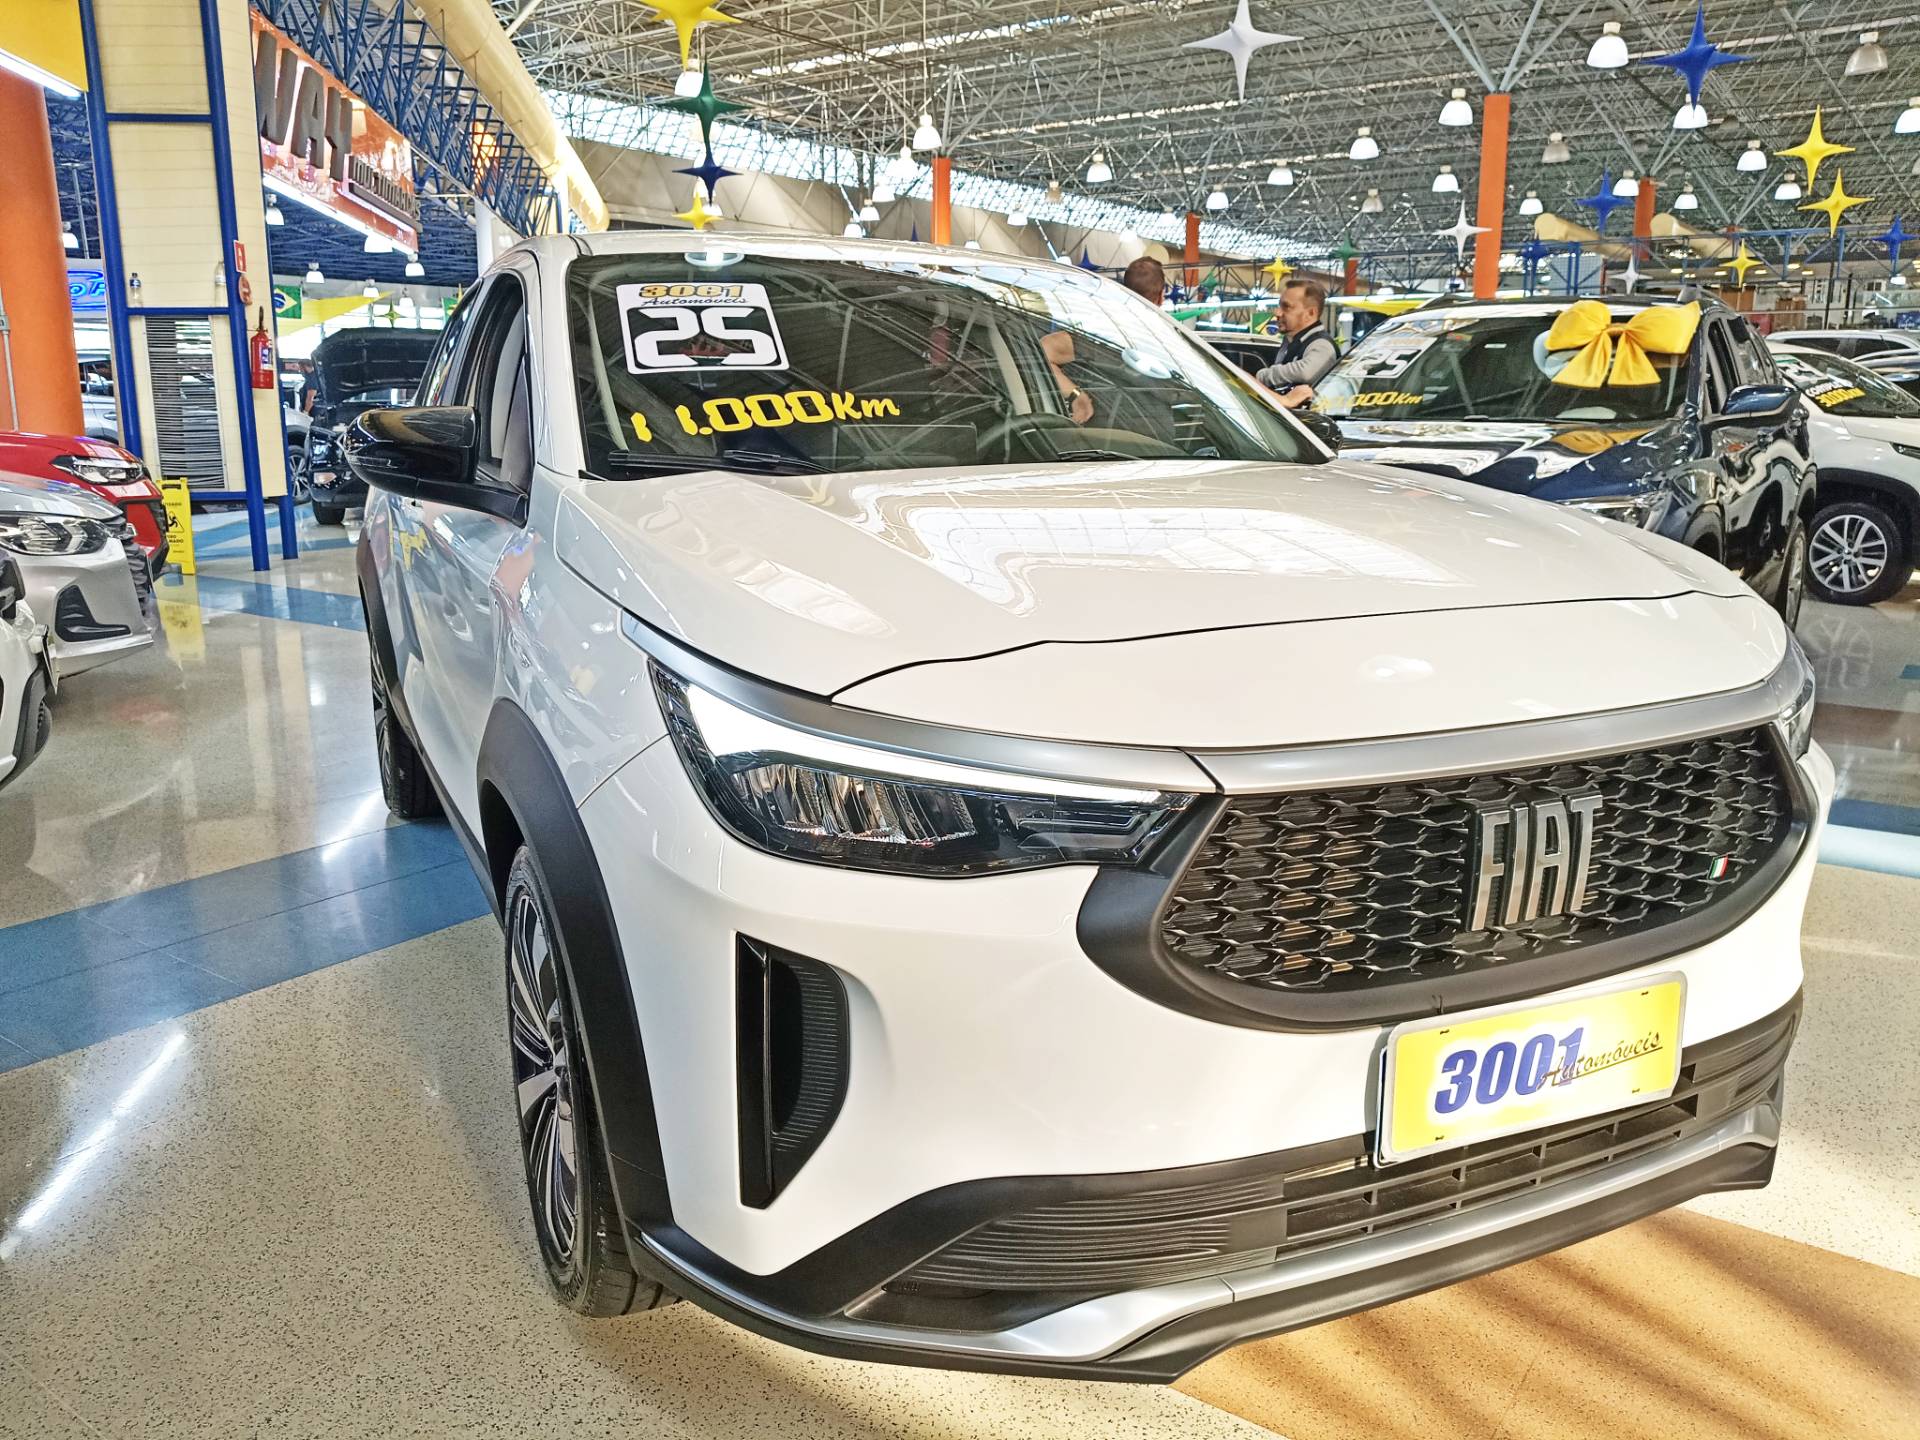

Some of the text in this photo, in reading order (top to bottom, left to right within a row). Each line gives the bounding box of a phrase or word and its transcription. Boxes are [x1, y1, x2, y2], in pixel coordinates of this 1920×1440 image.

[633, 307, 779, 367] 25
[1470, 794, 1603, 931] FIAT
[1435, 1027, 1663, 1114] 3001 Automóveis
